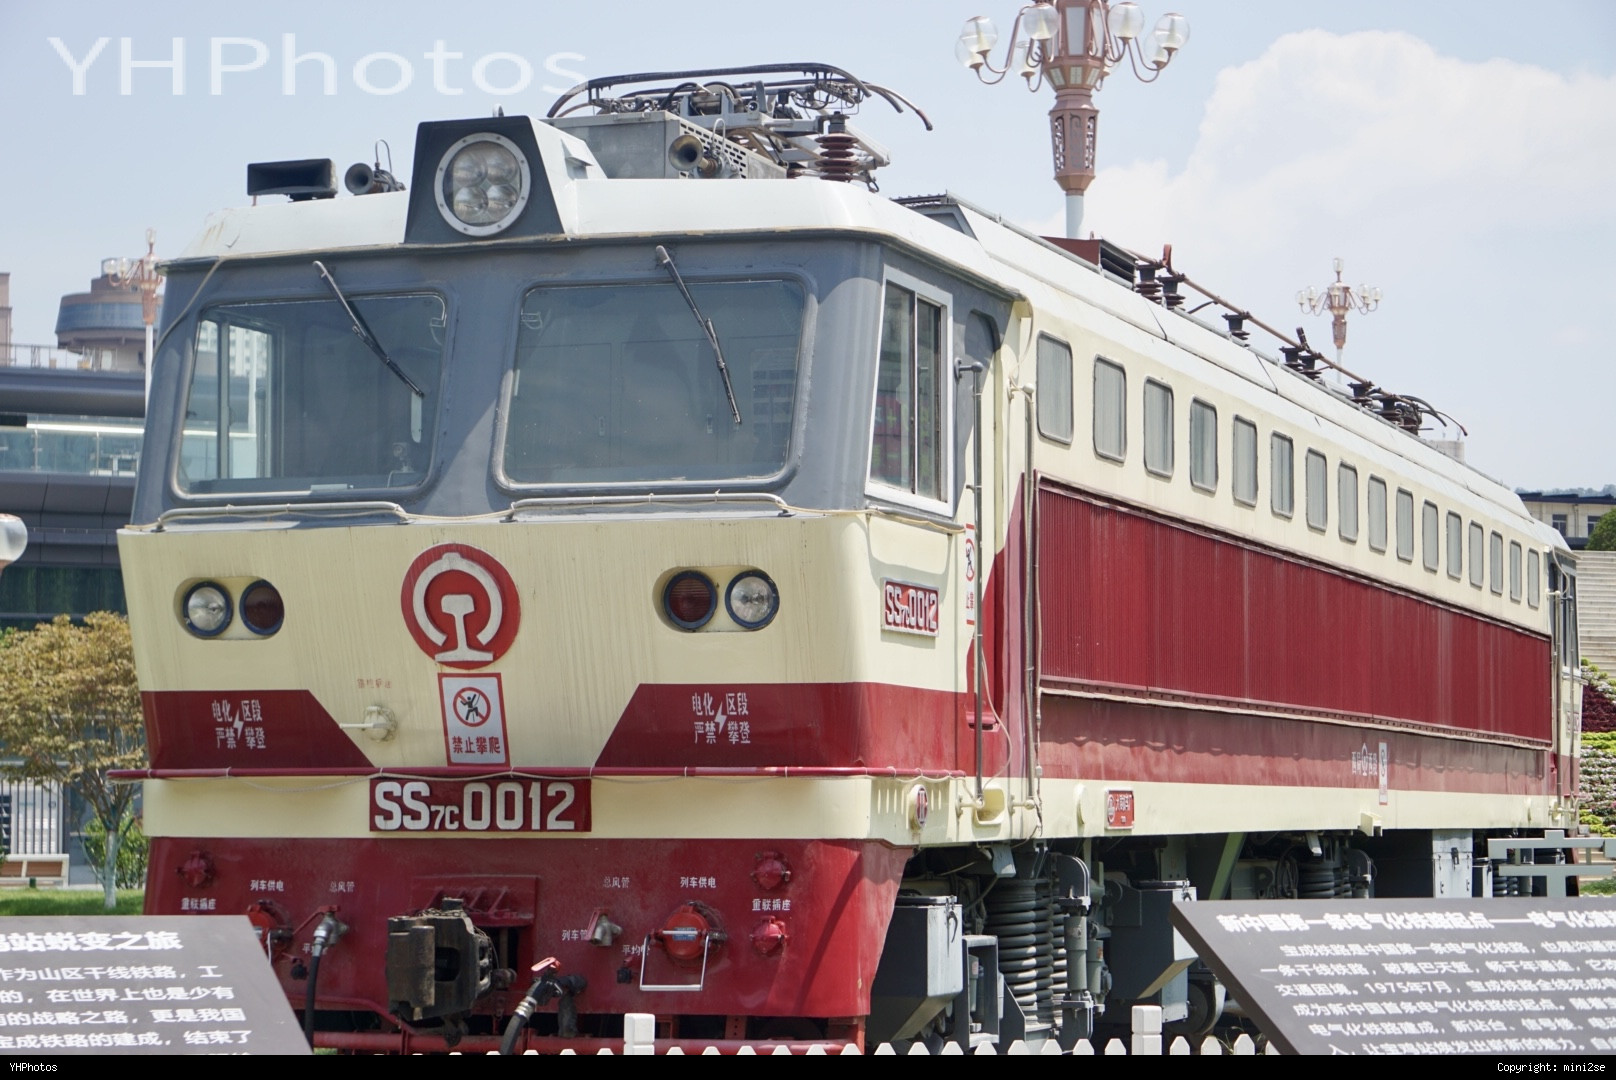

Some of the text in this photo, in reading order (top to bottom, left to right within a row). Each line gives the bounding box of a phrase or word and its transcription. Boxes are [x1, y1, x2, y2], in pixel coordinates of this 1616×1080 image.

[452, 736, 501, 755] 禁止攀爬
[374, 780, 576, 830] SS7C0012
[250, 880, 284, 892] 列车供电
[330, 881, 355, 893] 总风管
[603, 876, 630, 889] 总风管
[680, 876, 716, 889] 列车供电
[752, 898, 791, 911] 重联插座
